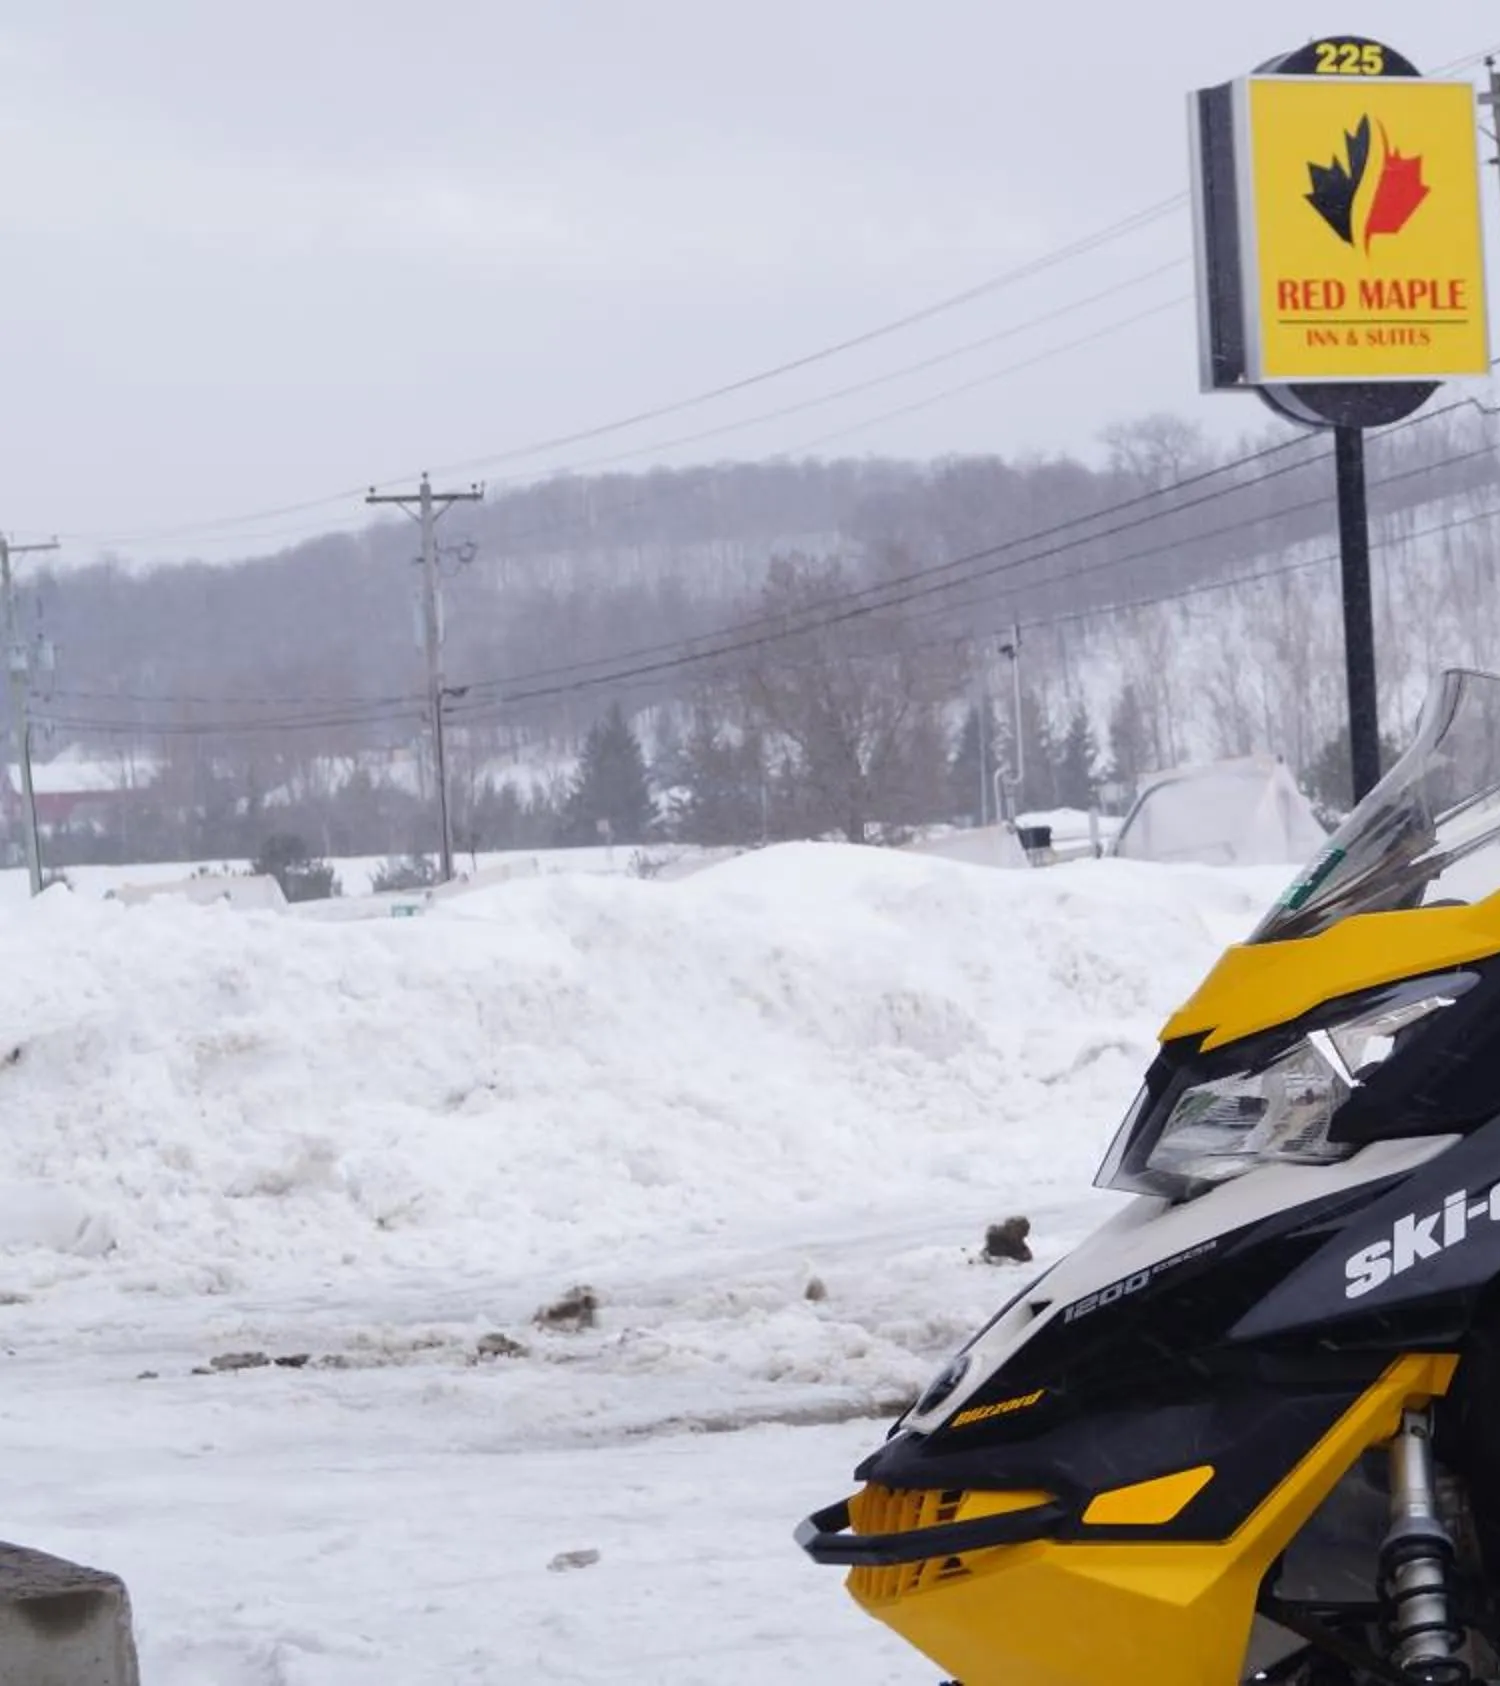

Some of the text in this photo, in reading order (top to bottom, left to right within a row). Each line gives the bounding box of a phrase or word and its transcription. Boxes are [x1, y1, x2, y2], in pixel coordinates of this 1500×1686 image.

[1315, 43, 1384, 75] 225
[1277, 278, 1468, 311] RED MAPLE
[1306, 328, 1431, 347] INN & SUITES
[1064, 1269, 1151, 1324] 1200
